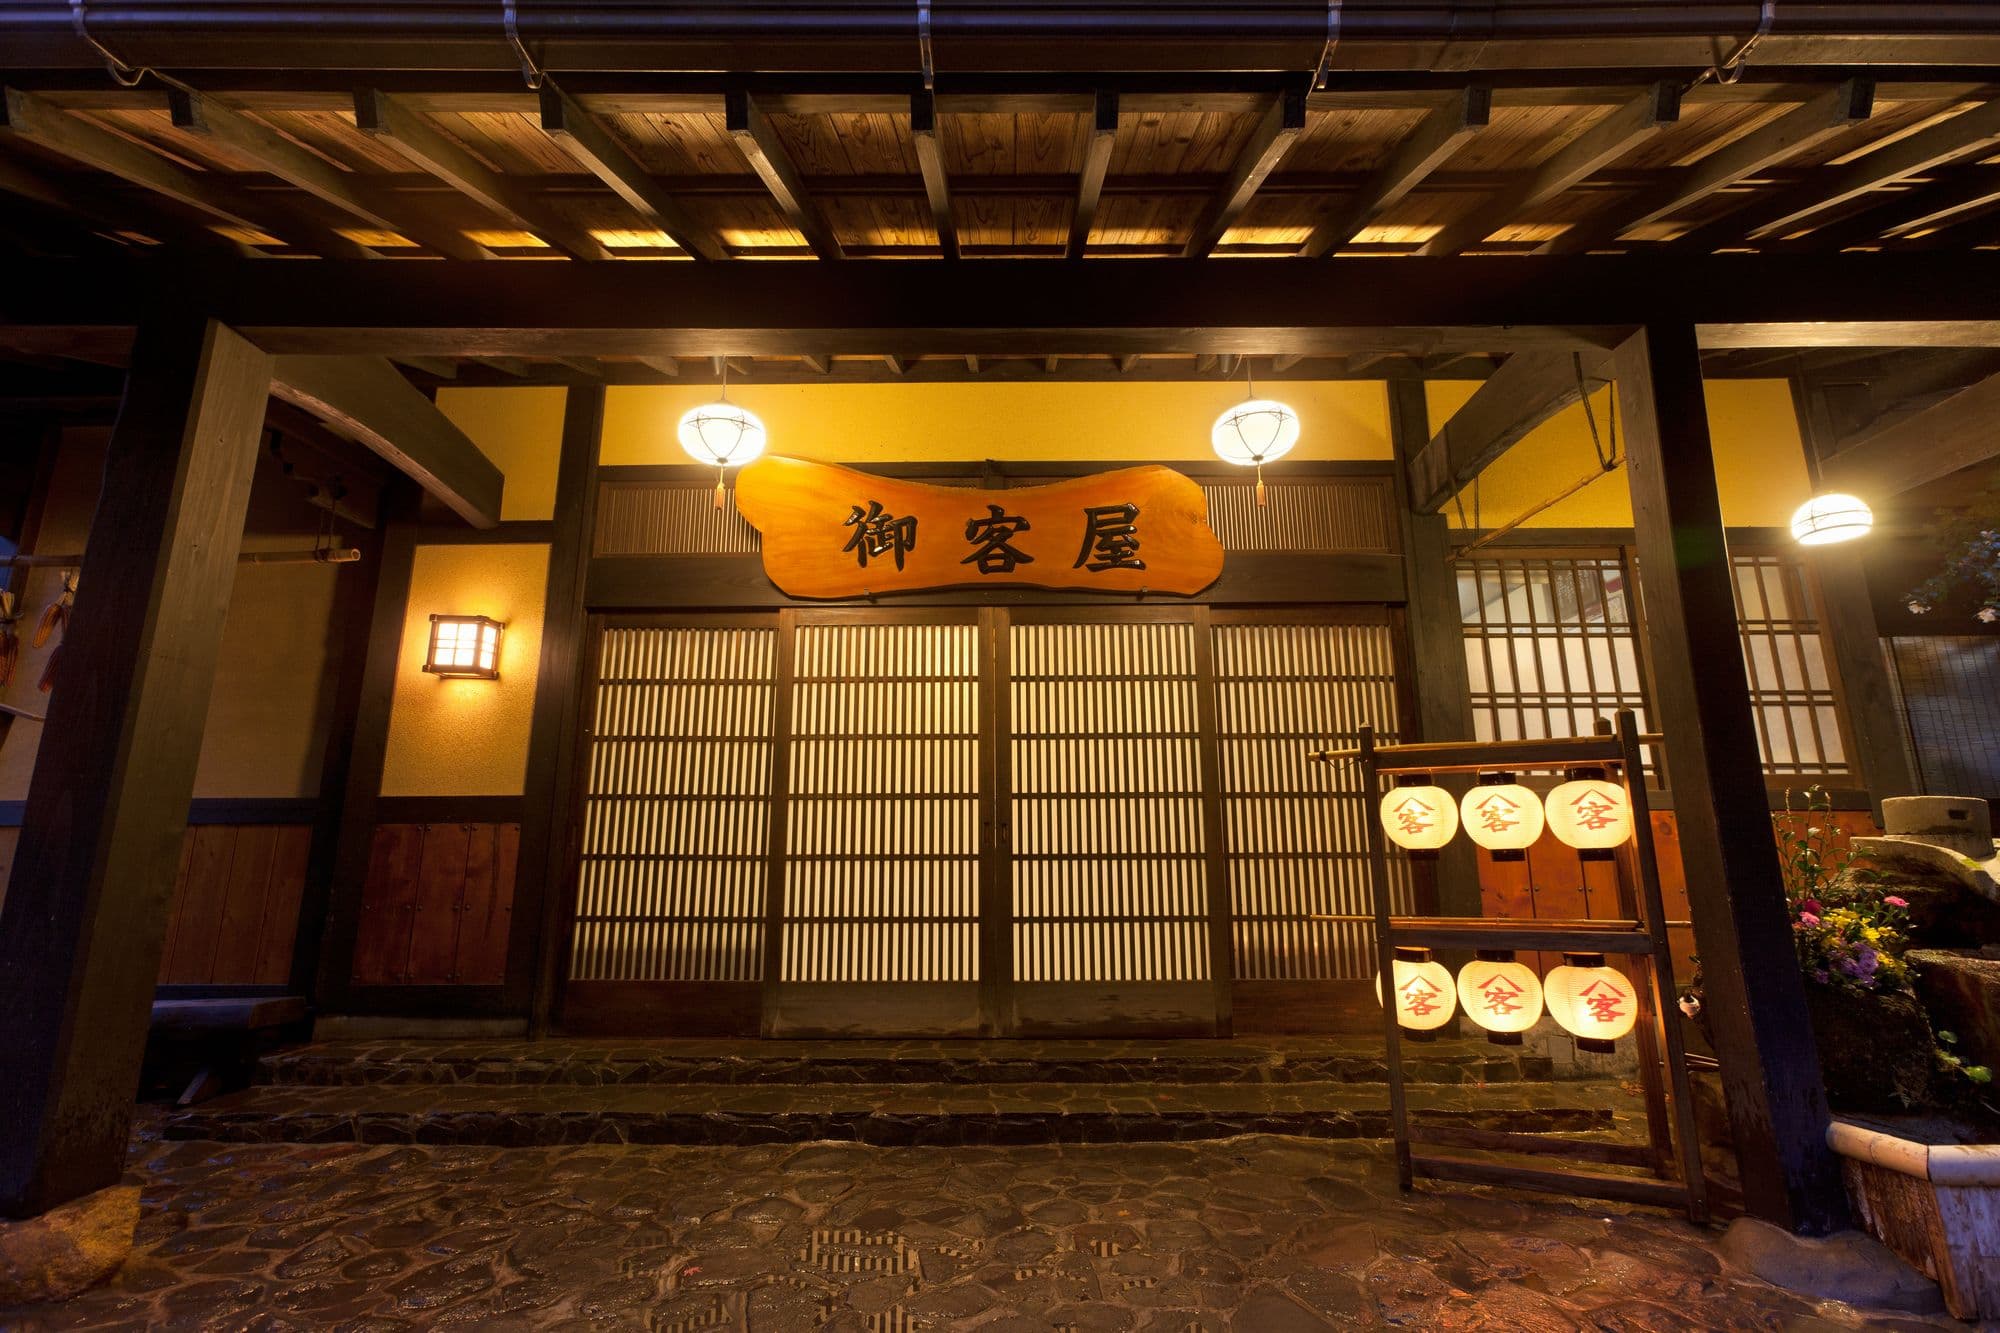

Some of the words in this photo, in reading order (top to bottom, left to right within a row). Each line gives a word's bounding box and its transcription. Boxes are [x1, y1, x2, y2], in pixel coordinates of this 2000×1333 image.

[842, 500, 1147, 575] 御客屋
[1397, 808, 1434, 835] 客
[1481, 805, 1520, 833] 客
[1575, 801, 1618, 831] 客
[1404, 989, 1441, 1017] 客
[1483, 986, 1523, 1015] 客
[1585, 993, 1626, 1023] 客
